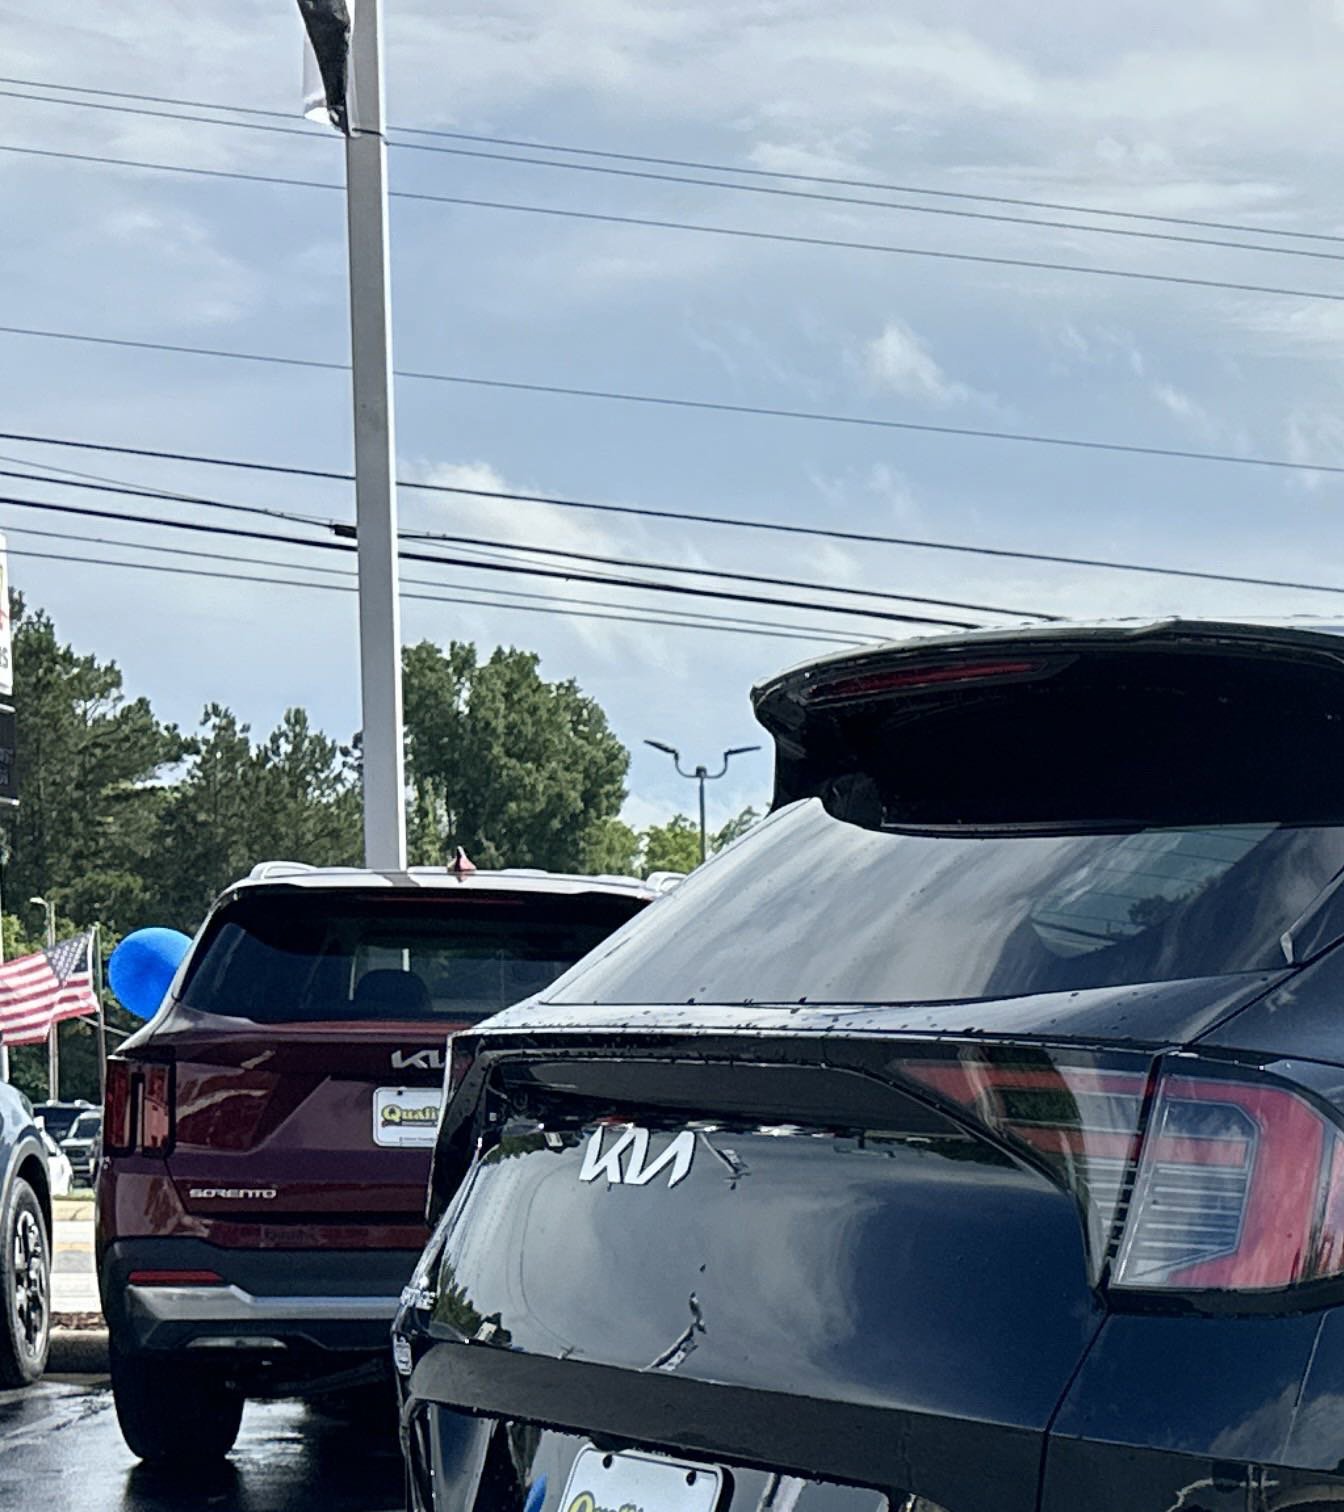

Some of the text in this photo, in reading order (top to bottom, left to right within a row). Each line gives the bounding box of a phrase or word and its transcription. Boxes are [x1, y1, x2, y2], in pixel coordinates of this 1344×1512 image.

[391, 1050, 446, 1069] KI
[382, 1104, 441, 1123] Quali
[578, 1126, 696, 1188] KIA
[190, 1189, 277, 1199] SORENTO
